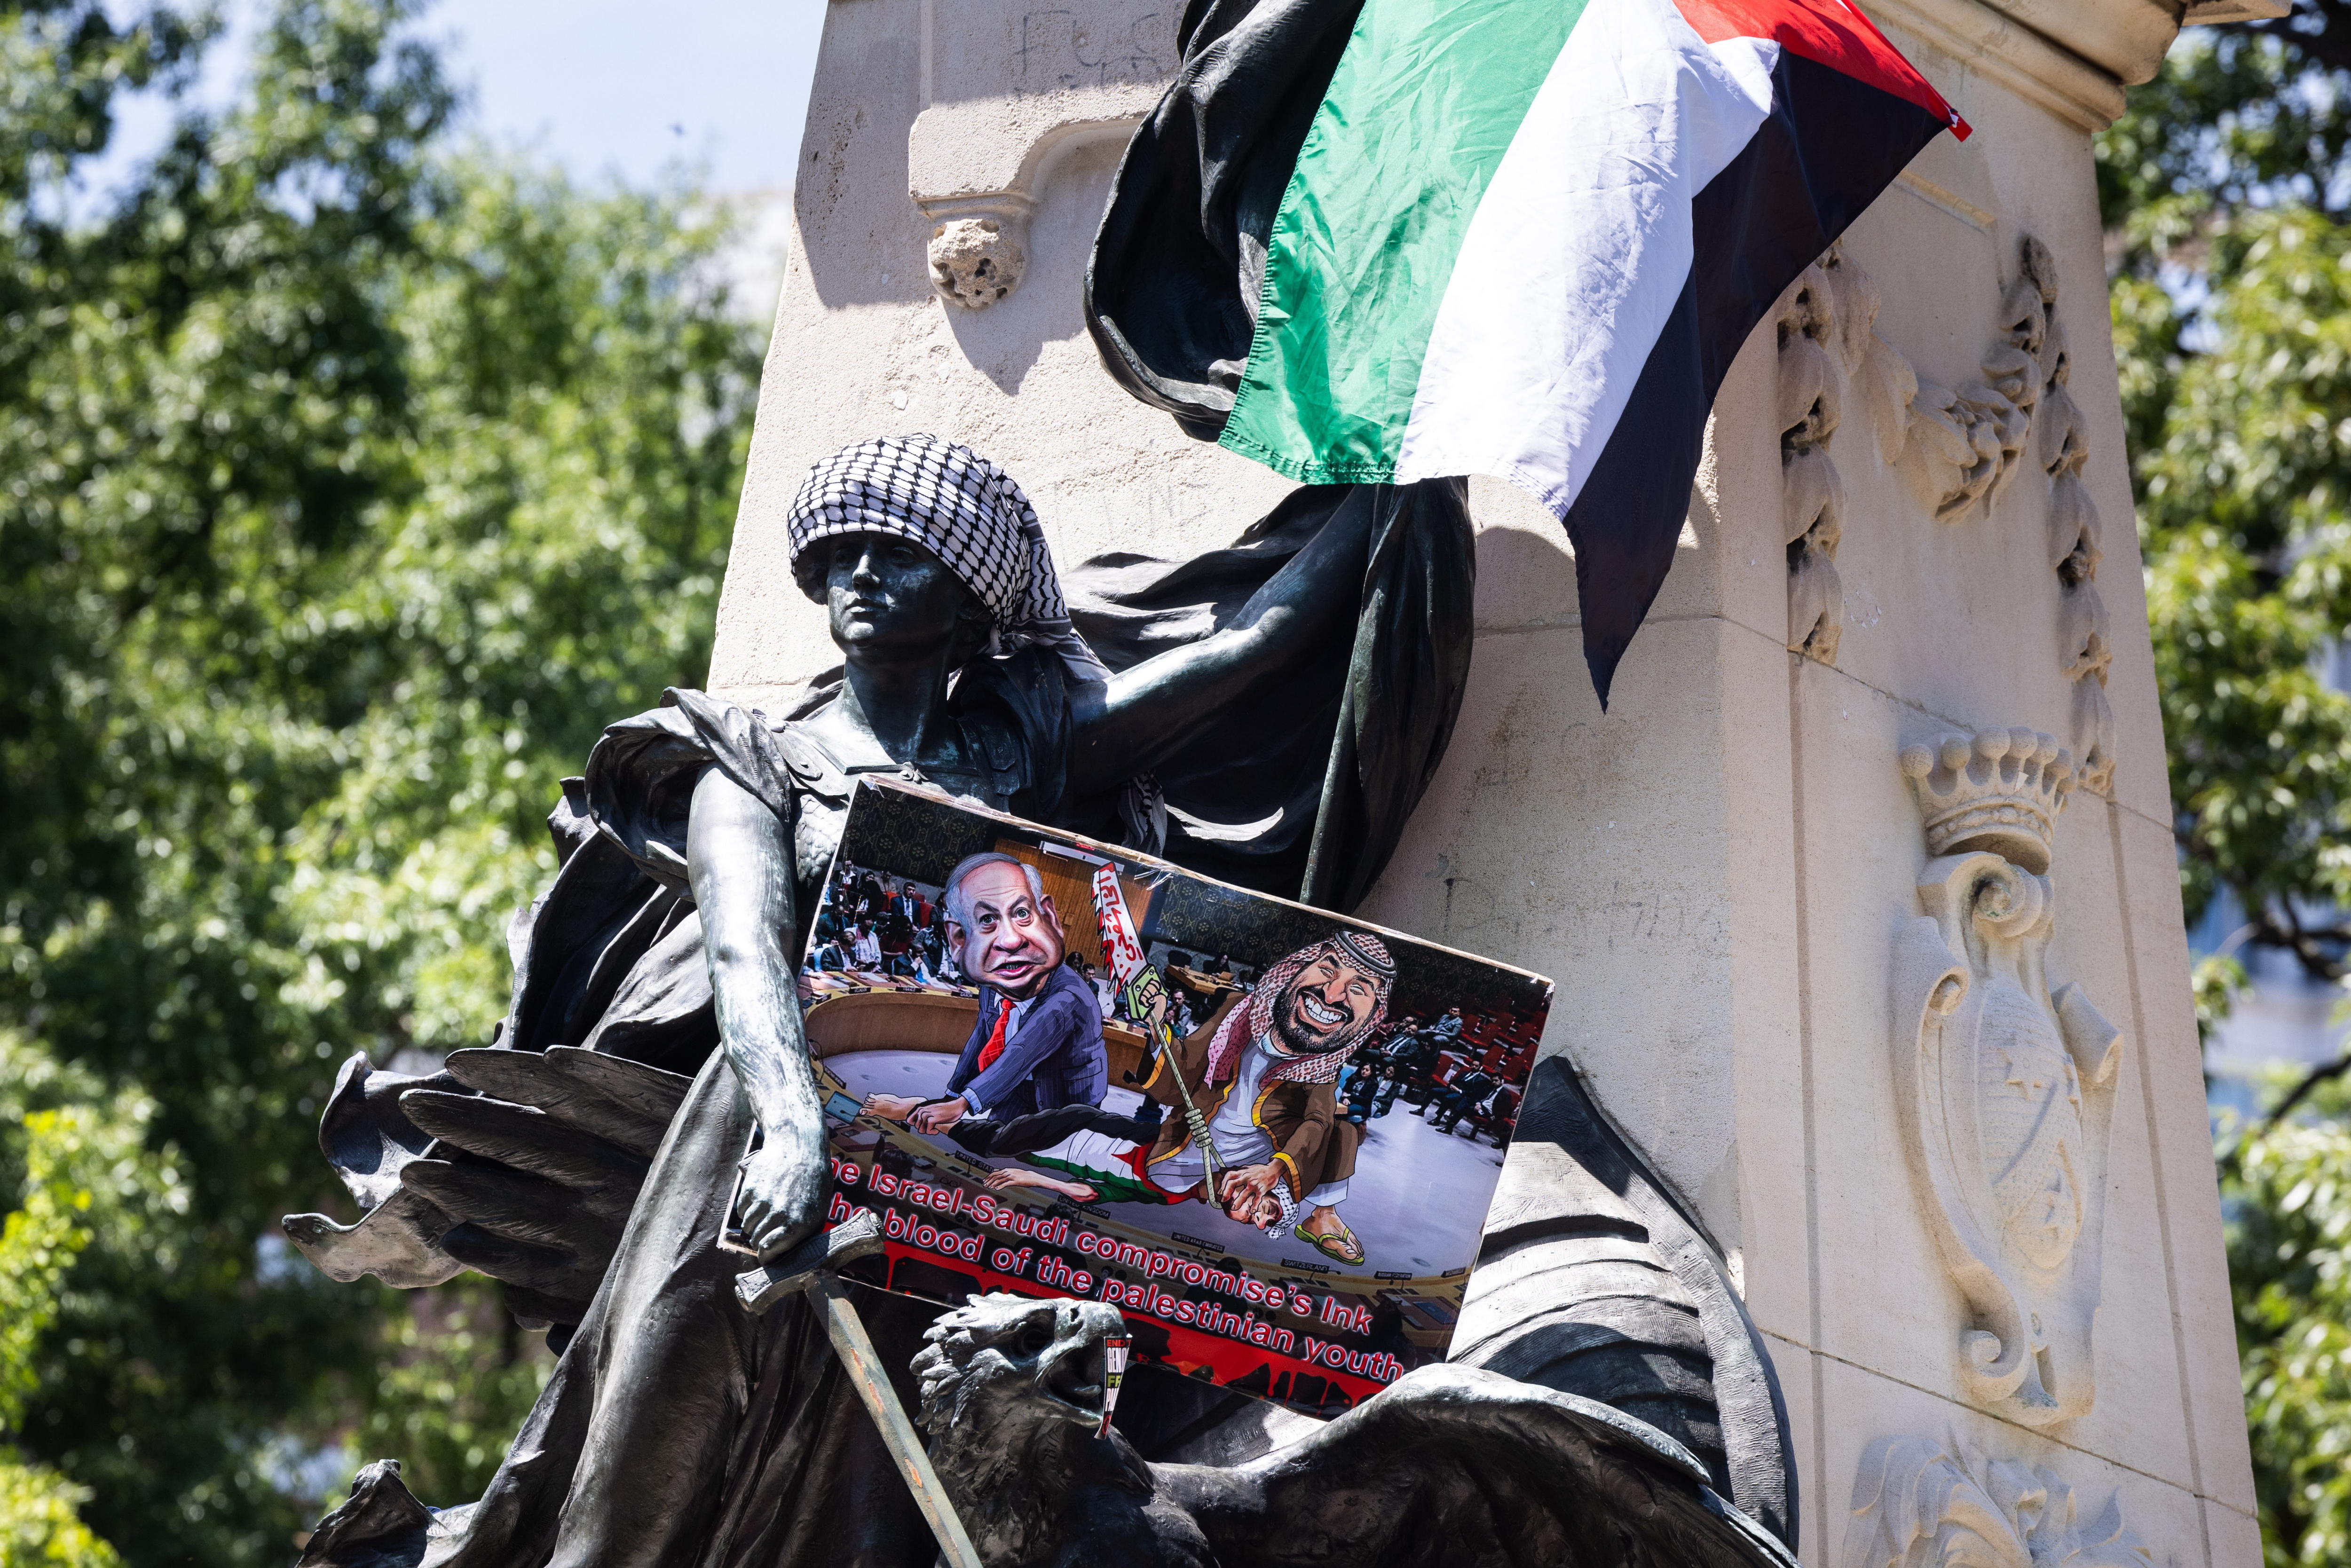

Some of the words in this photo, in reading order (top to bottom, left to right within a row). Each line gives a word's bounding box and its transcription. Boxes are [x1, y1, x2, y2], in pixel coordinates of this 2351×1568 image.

[868, 1164, 1070, 1246] Israel-Saudi
[1321, 1296, 1373, 1335] Ink
[884, 1208, 985, 1262] blood
[992, 1247, 1034, 1275] of
[1038, 1255, 1093, 1293] the
[1101, 1277, 1295, 1353] palestinian
[1301, 1337, 1404, 1381] youth
[1284, 1260, 1328, 1272] SWITZERLAND
